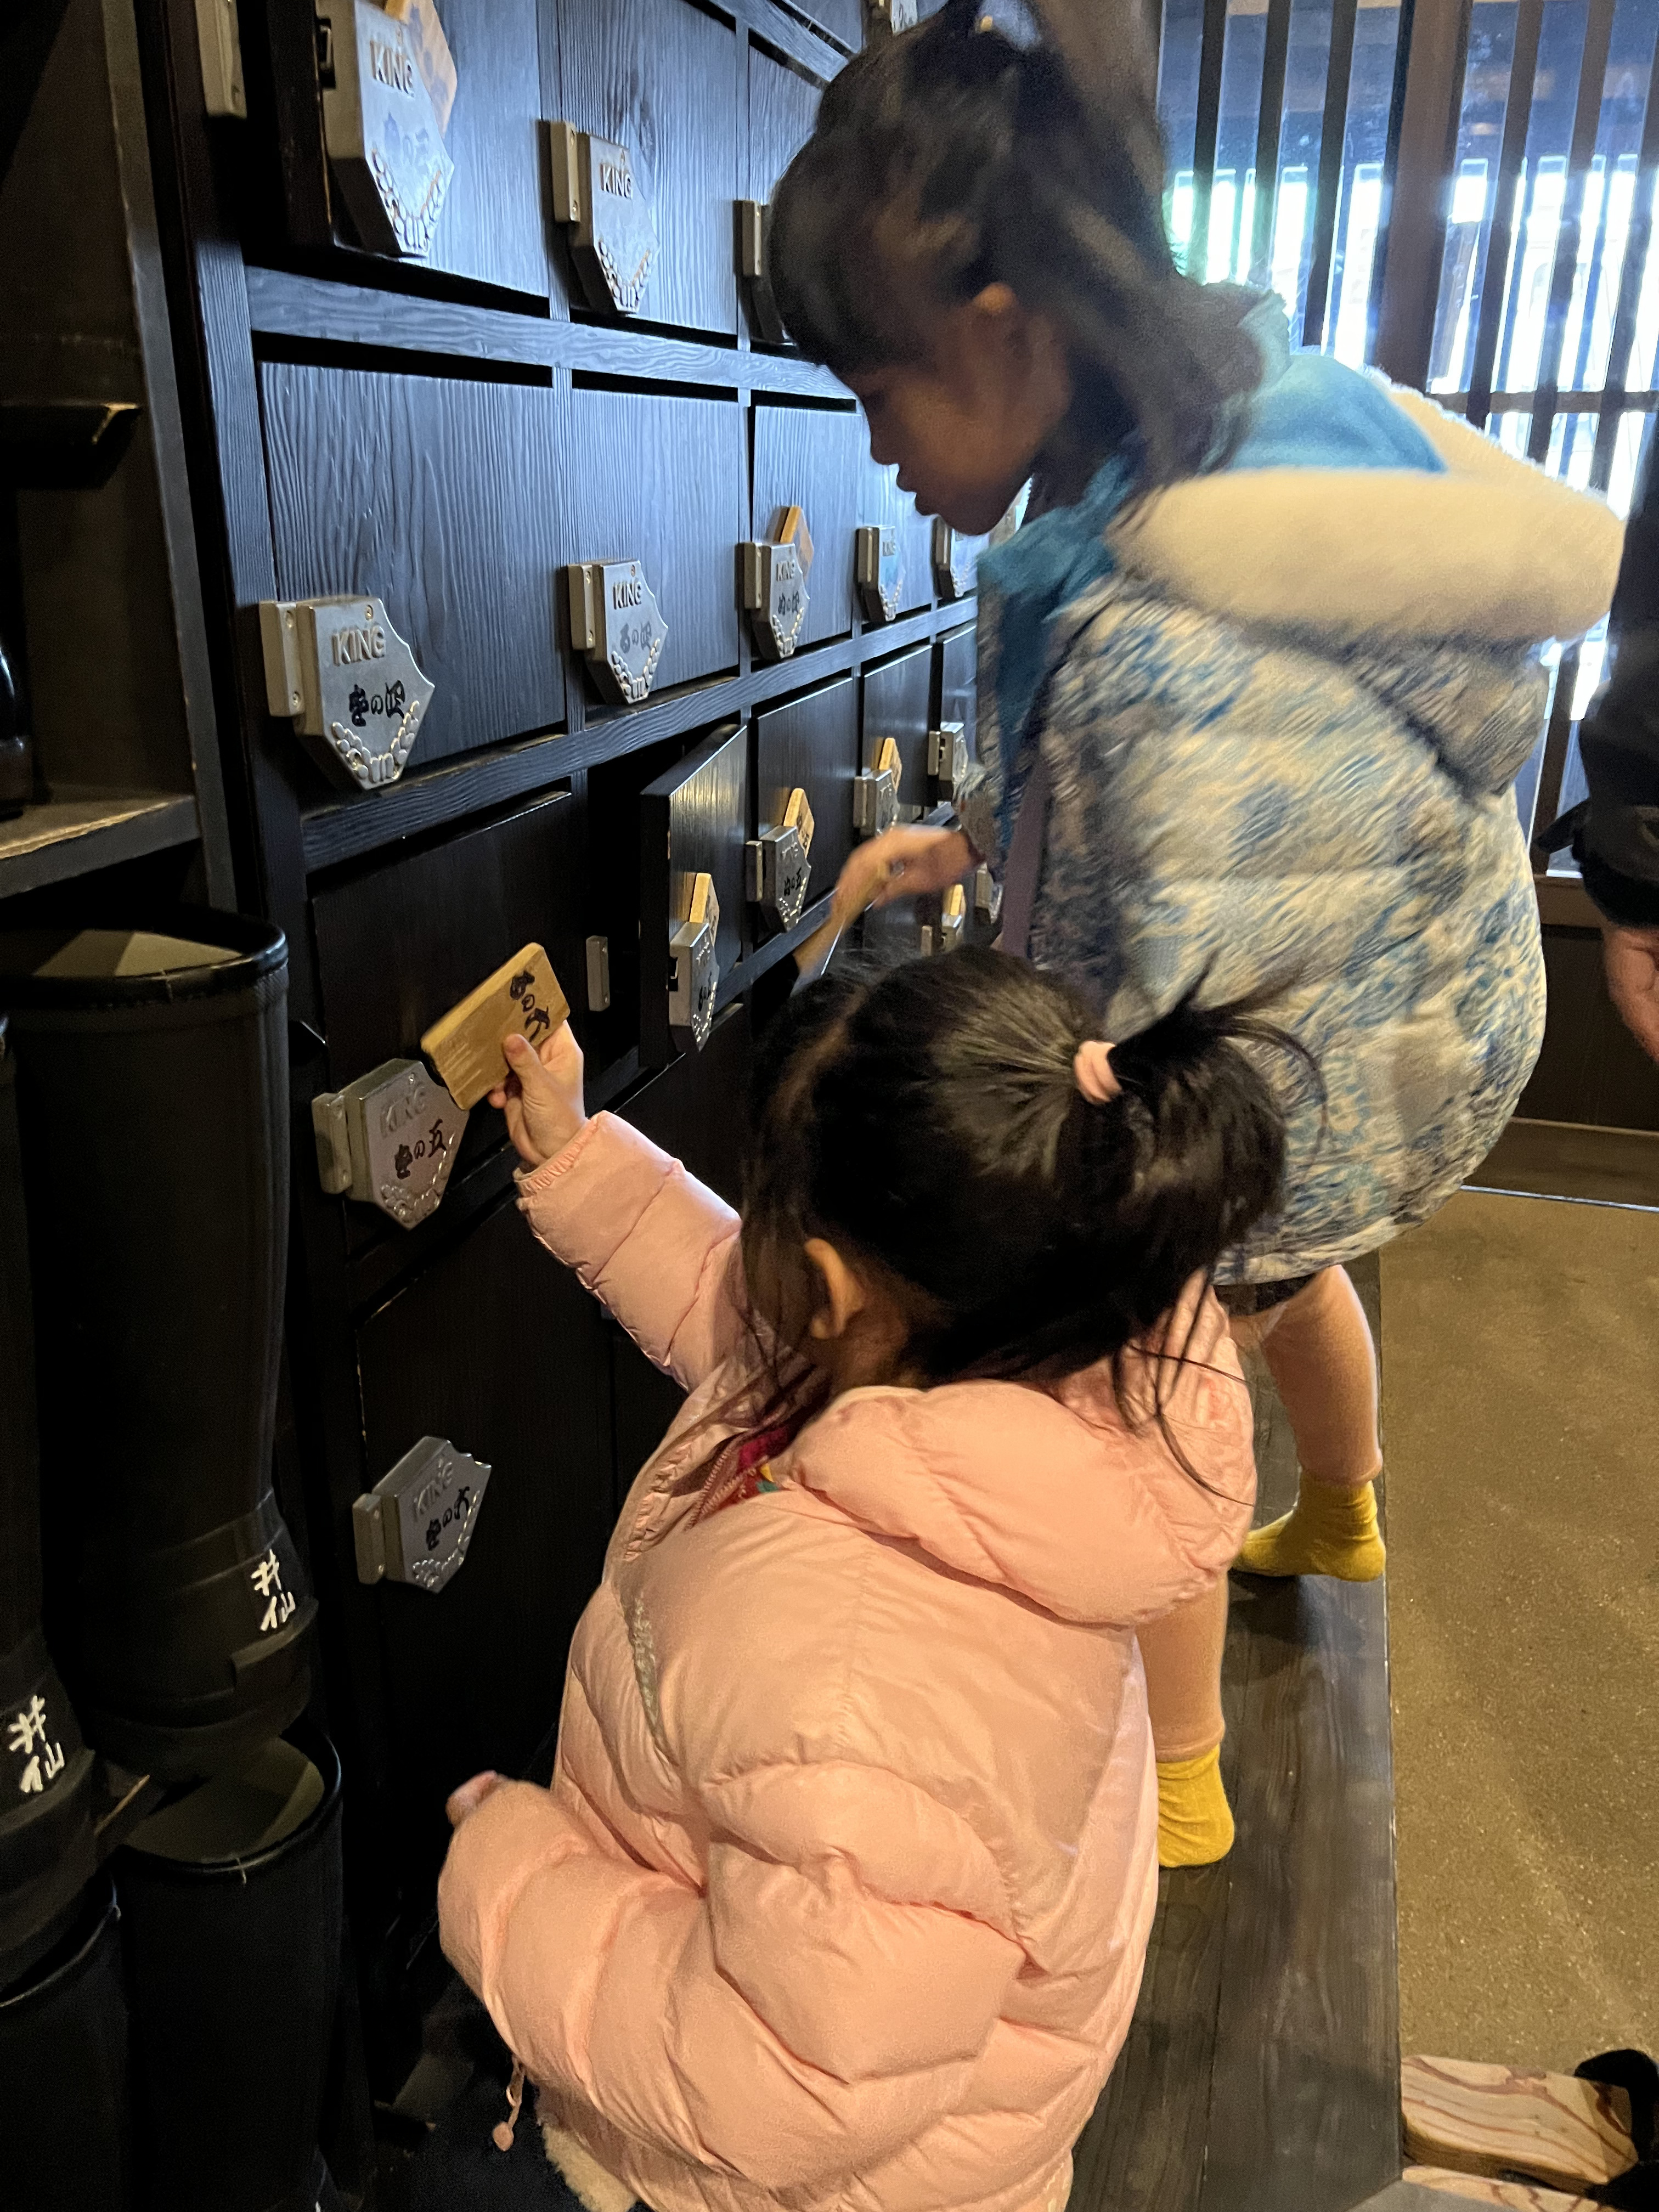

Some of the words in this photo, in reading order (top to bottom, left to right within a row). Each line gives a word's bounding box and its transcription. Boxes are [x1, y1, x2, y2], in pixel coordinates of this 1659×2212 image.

[369, 39, 414, 98] KING
[600, 163, 633, 199] KING
[613, 580, 642, 610] KING
[332, 623, 385, 667] KING
